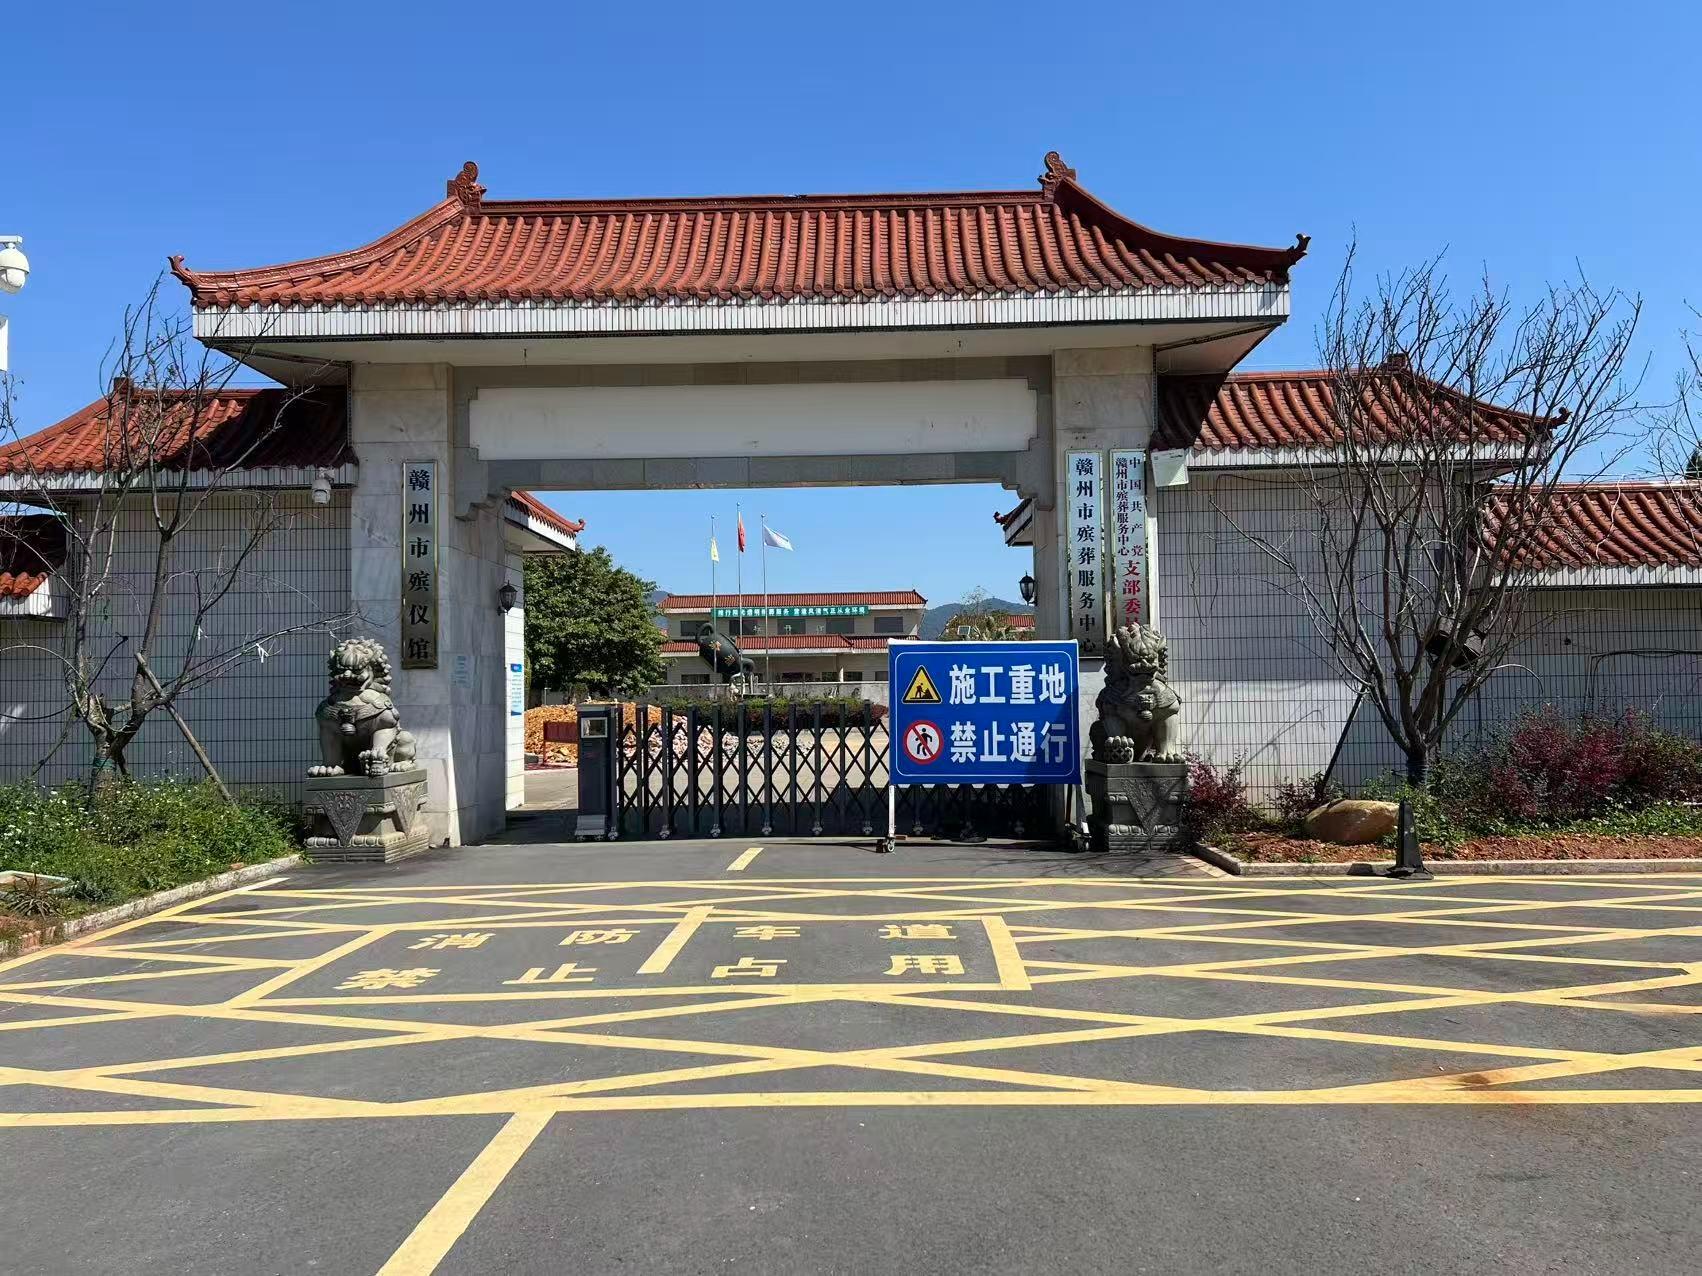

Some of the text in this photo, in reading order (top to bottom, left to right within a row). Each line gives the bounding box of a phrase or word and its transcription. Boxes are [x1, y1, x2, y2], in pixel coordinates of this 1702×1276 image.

[1115, 457, 1129, 556] 赣州市殡葬服务中心
[1129, 457, 1143, 557] 中国共产党
[408, 469, 431, 660] 赣州市殡仪馆
[1076, 457, 1097, 653] 赣州市殡葬服务中心
[949, 663, 1067, 705] 施工重地
[950, 720, 1068, 764] 禁止通行
[333, 954, 965, 990] 禁止占用
[407, 924, 957, 950] 消防车道
